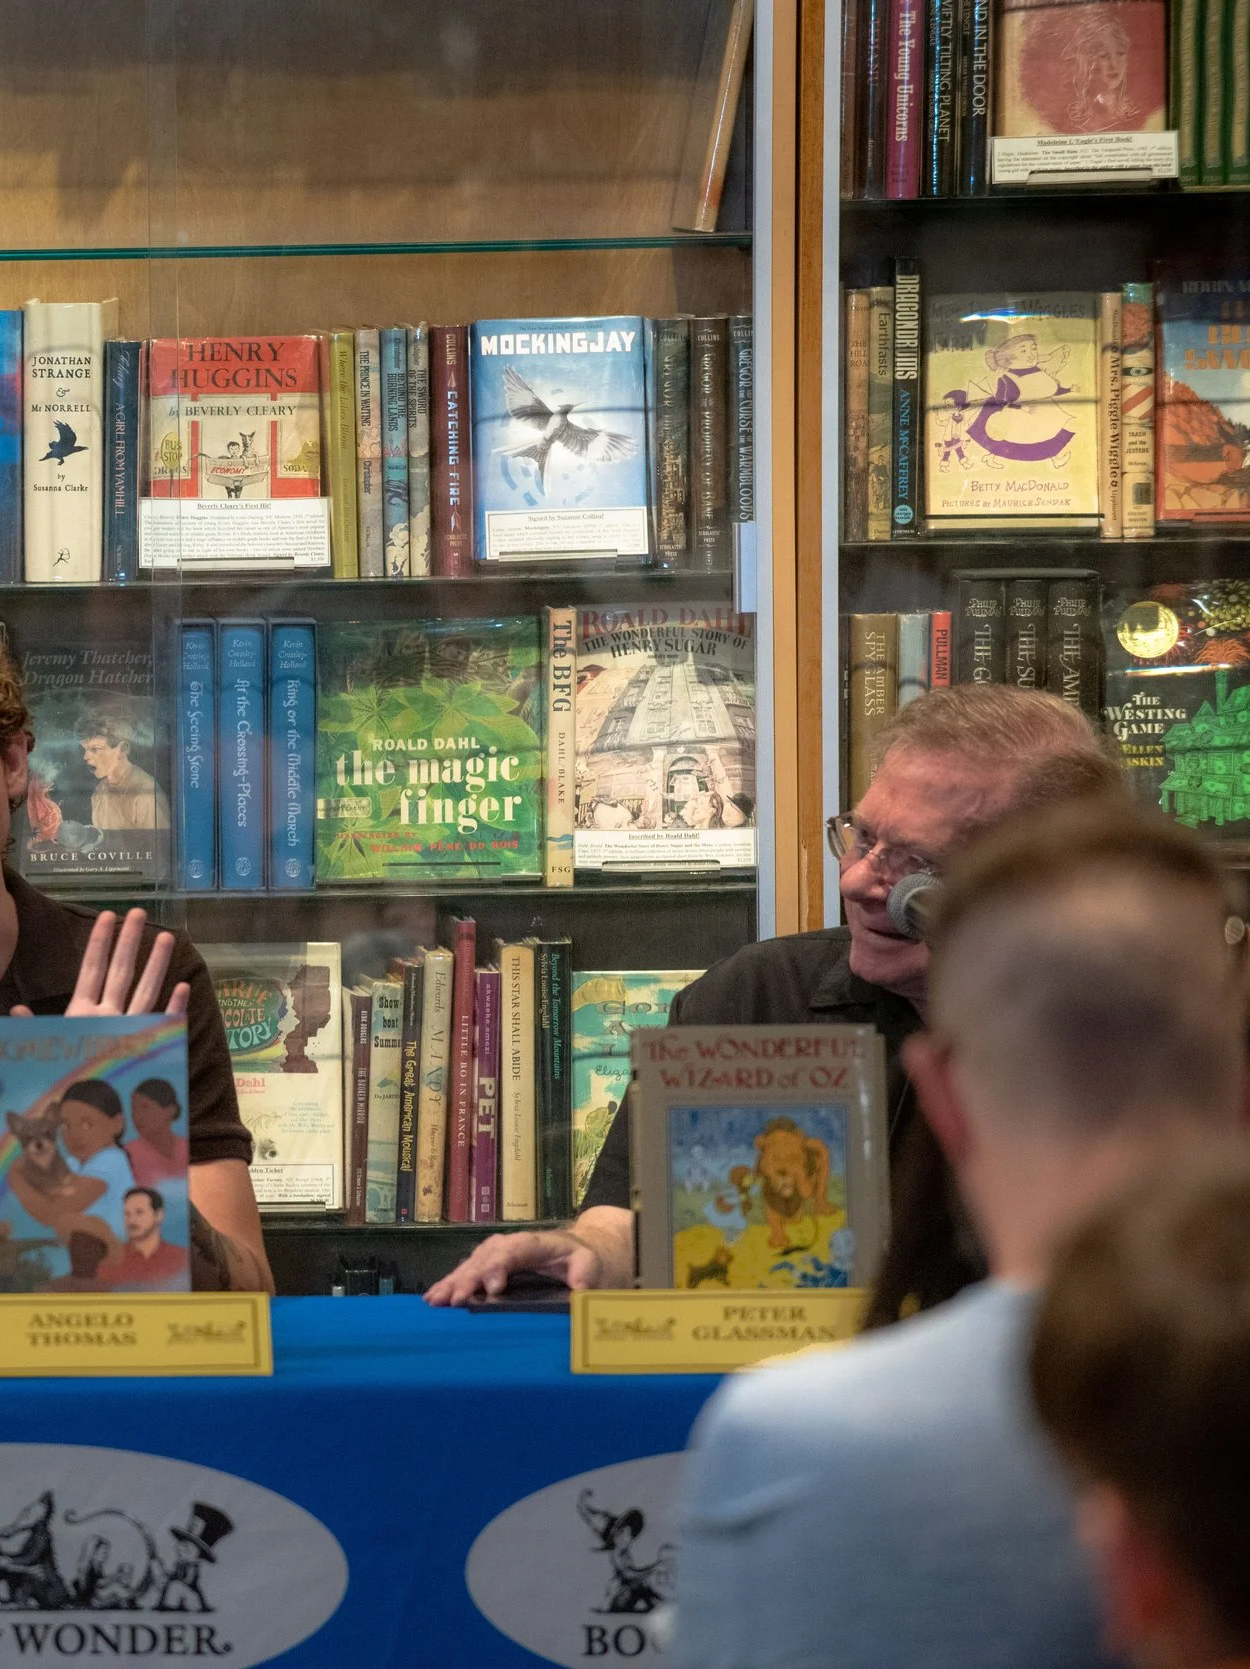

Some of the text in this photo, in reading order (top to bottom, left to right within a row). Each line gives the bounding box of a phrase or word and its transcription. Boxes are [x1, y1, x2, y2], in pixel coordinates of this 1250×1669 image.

[894, 11, 916, 142] The Young Unicorns
[972, 25, 988, 117] IN THE DOOR
[938, 98, 950, 142] PLANET
[187, 342, 286, 363] HENRY
[445, 333, 454, 365] COLLINS
[481, 331, 635, 356] MOCKINGJAY
[877, 312, 890, 376] Earthfasts
[895, 274, 919, 428] DRAGONDRUMS ANNE
[32, 355, 92, 367] JONATHAN
[32, 368, 92, 379] STRANGE
[171, 368, 298, 389] HUGGINS
[44, 404, 92, 412] NORRELL
[185, 405, 296, 417] BEVERLY CLEARY
[165, 439, 182, 451] BUS
[1108, 391, 1121, 479] Piggle-Wiggle
[164, 451, 183, 461] STOP
[447, 391, 461, 507] CATCHING FIRE
[33, 484, 89, 492] Susanna Clarke
[971, 481, 1000, 492] BETTY
[582, 608, 668, 640] ROALD
[583, 625, 750, 652] THE WONDERFUL STORY OF
[610, 638, 717, 659] HENRY SUGAR
[22, 650, 153, 668] Jeremy Thatcher,
[552, 620, 572, 712] The BFG
[934, 629, 948, 681] PULLMAN
[23, 670, 154, 687] Dragon Hatcher
[863, 631, 876, 717] SPY GLASS
[877, 632, 885, 715] THE AMBER
[1132, 692, 1161, 706] THE
[1101, 703, 1187, 720] WESTING
[1113, 721, 1164, 741] GAME
[373, 738, 480, 751] ROALD DAHL
[336, 746, 520, 793] the magic
[400, 788, 523, 834] finger
[30, 852, 153, 862] BRUCE COVILLE
[379, 996, 399, 1009] Show
[432, 971, 446, 1013] Edwards
[540, 953, 549, 1029] Sylvia Louise Engdahl
[382, 1016, 399, 1029] boat
[511, 956, 521, 1081] THIS STAR SHALL ABIDE
[405, 1040, 417, 1060] The
[236, 1078, 265, 1088] Dahl
[405, 1062, 417, 1088] Great
[457, 1015, 469, 1148] LITTLE BO IN FRANCE
[661, 1064, 850, 1090] WIZARD OZ
[403, 1091, 416, 1132] American
[478, 1076, 495, 1140] PET
[400, 1135, 413, 1172] Musical
[27, 1311, 134, 1329] ANGELO
[723, 1305, 806, 1322] PETER
[25, 1331, 137, 1347] THOMAS
[692, 1325, 838, 1341] GLASSMAN
